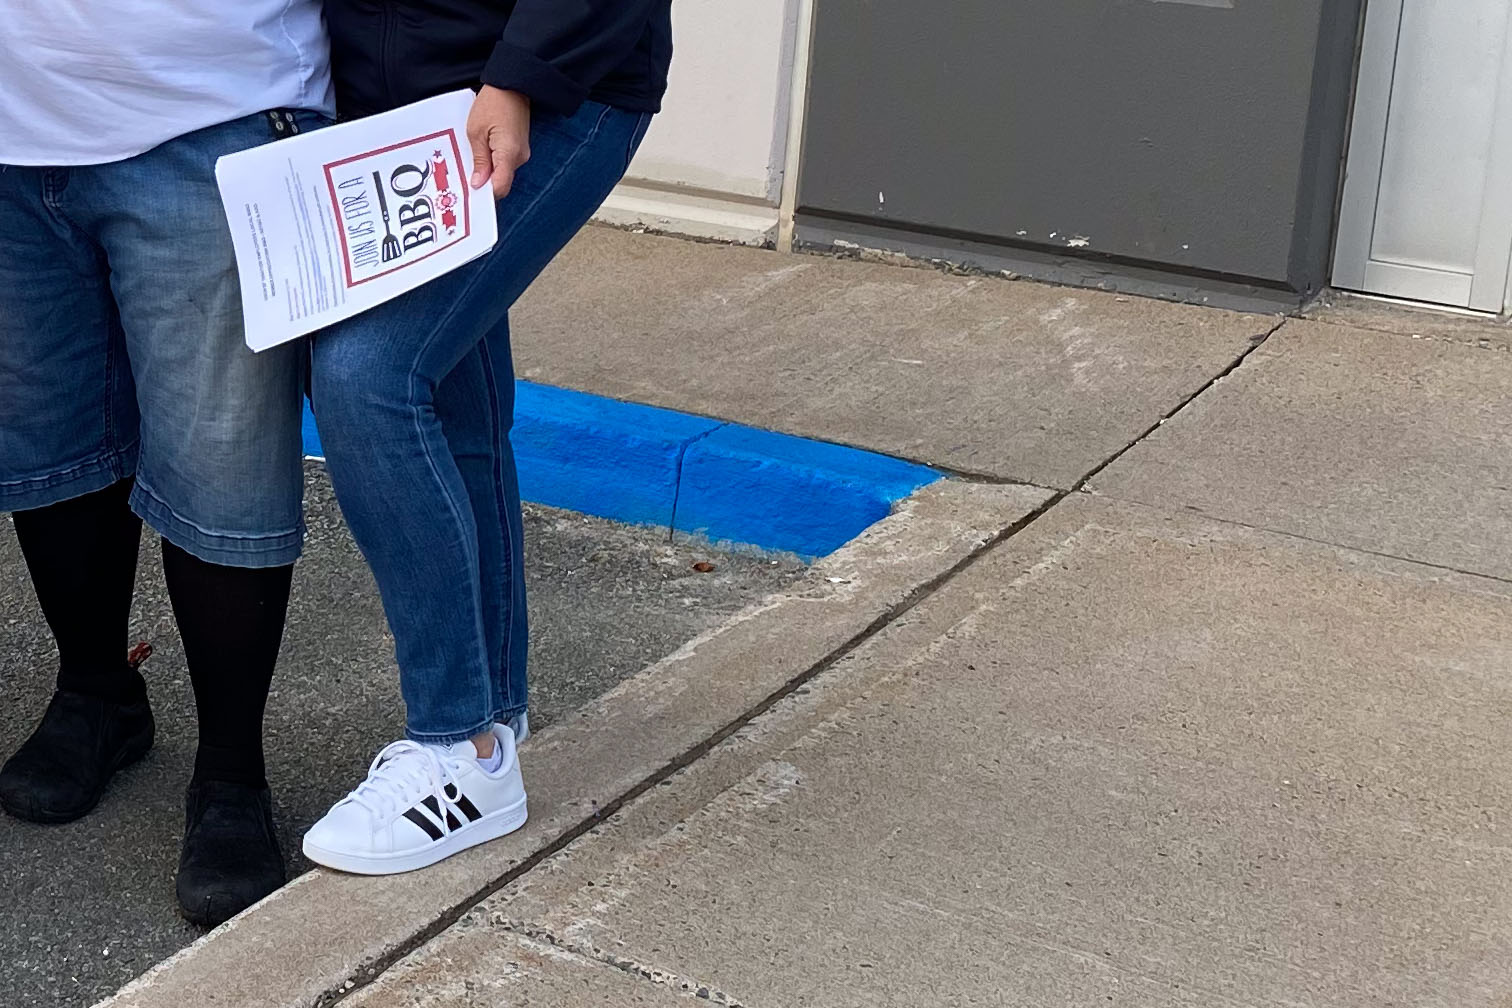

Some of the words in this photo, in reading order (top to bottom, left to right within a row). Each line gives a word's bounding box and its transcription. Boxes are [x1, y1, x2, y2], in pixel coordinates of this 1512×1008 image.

[338, 176, 364, 189] A
[342, 190, 372, 220] FOR
[390, 159, 436, 253] BBQ
[348, 220, 376, 239] US
[351, 239, 379, 268] JOIN
